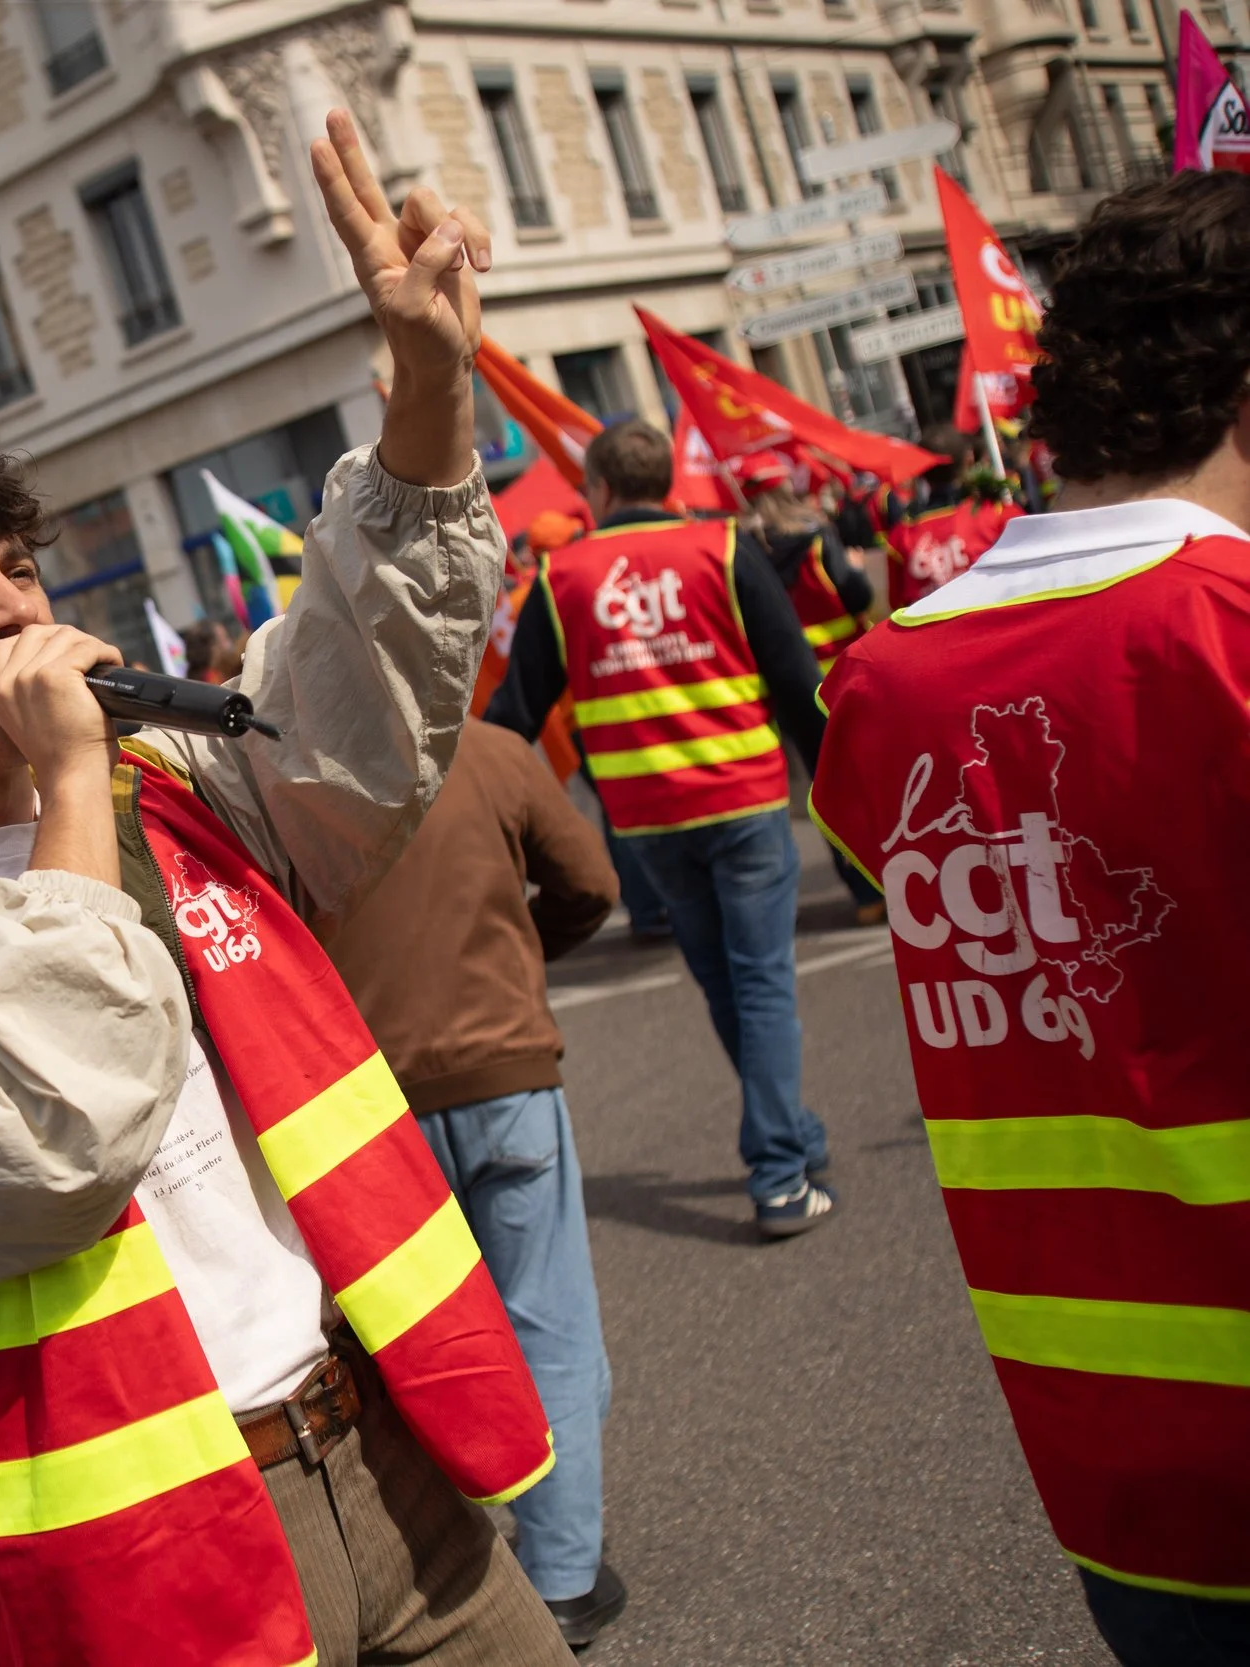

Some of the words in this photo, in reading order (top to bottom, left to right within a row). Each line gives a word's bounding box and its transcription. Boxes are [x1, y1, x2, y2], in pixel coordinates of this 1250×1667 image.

[593, 568, 687, 638] cgt
[881, 752, 1012, 853] la
[175, 881, 242, 945] cgt
[881, 812, 1081, 976] cgt
[226, 933, 262, 963] 69
[909, 980, 1009, 1049] UD
[1021, 972, 1096, 1061] 69
[195, 1130, 223, 1152] Fleury
[153, 1187, 165, 1199] 13
